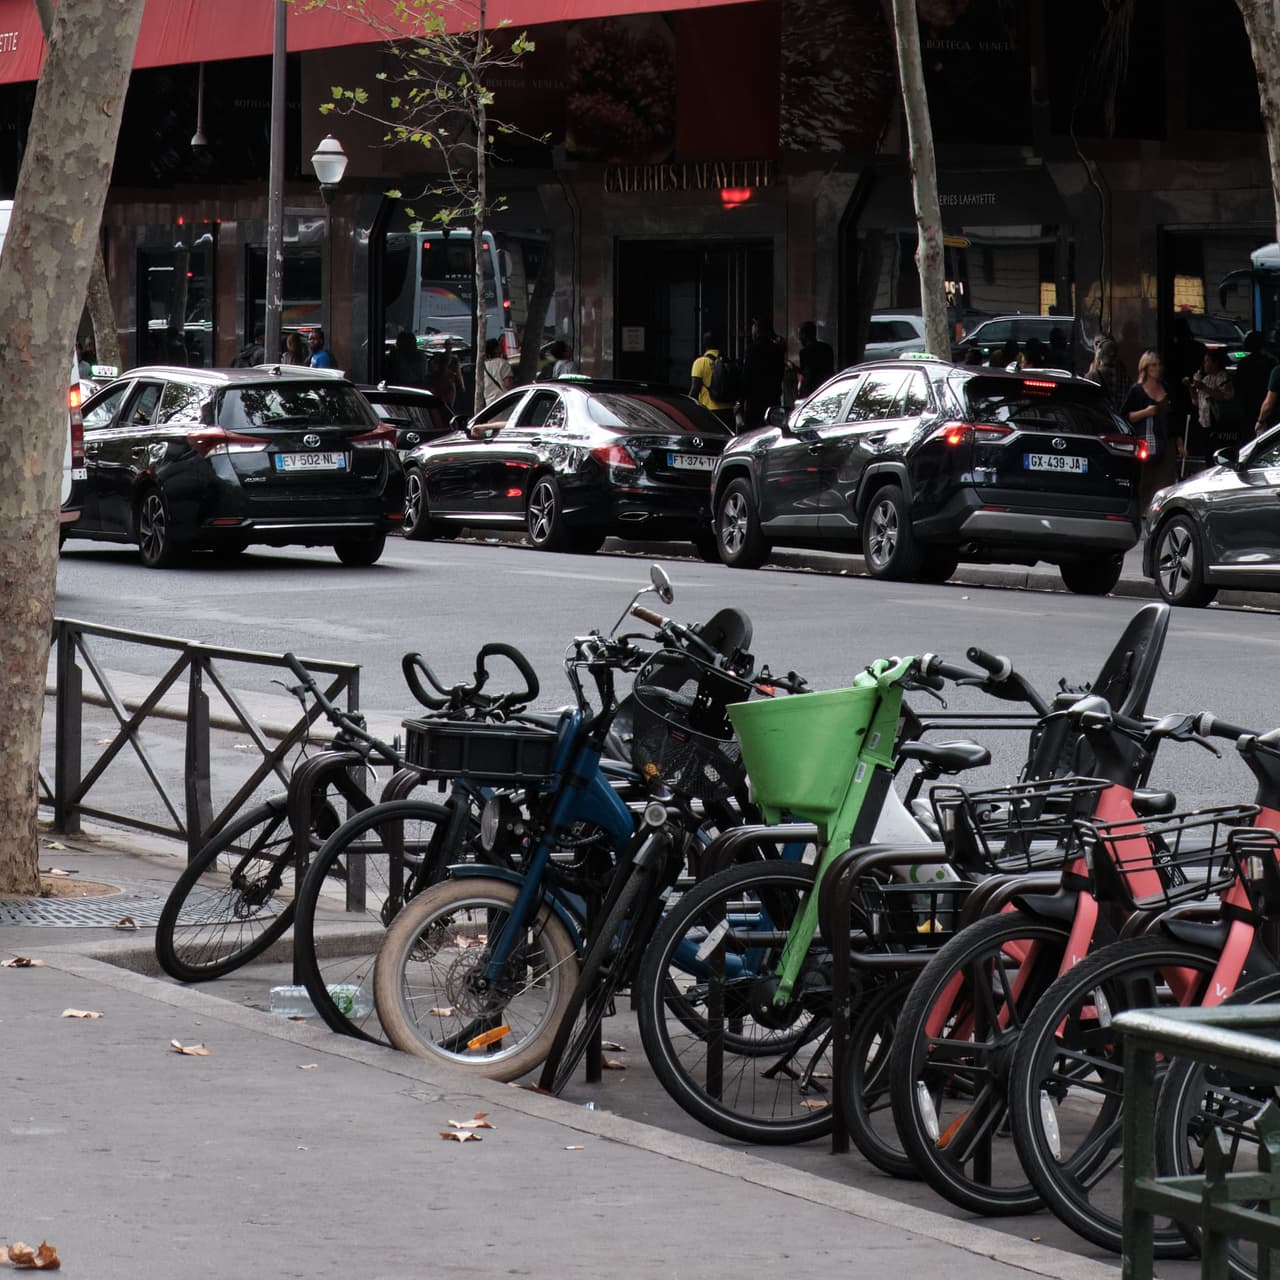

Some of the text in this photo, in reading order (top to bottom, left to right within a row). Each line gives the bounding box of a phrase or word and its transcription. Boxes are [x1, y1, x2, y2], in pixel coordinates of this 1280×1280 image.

[604, 160, 769, 193] GALERIES LAFAYETTE
[938, 193, 997, 206] ERIES LAFAYETTE
[283, 454, 337, 467] EV-502-NL
[1031, 456, 1081, 470] GX-439-JA
